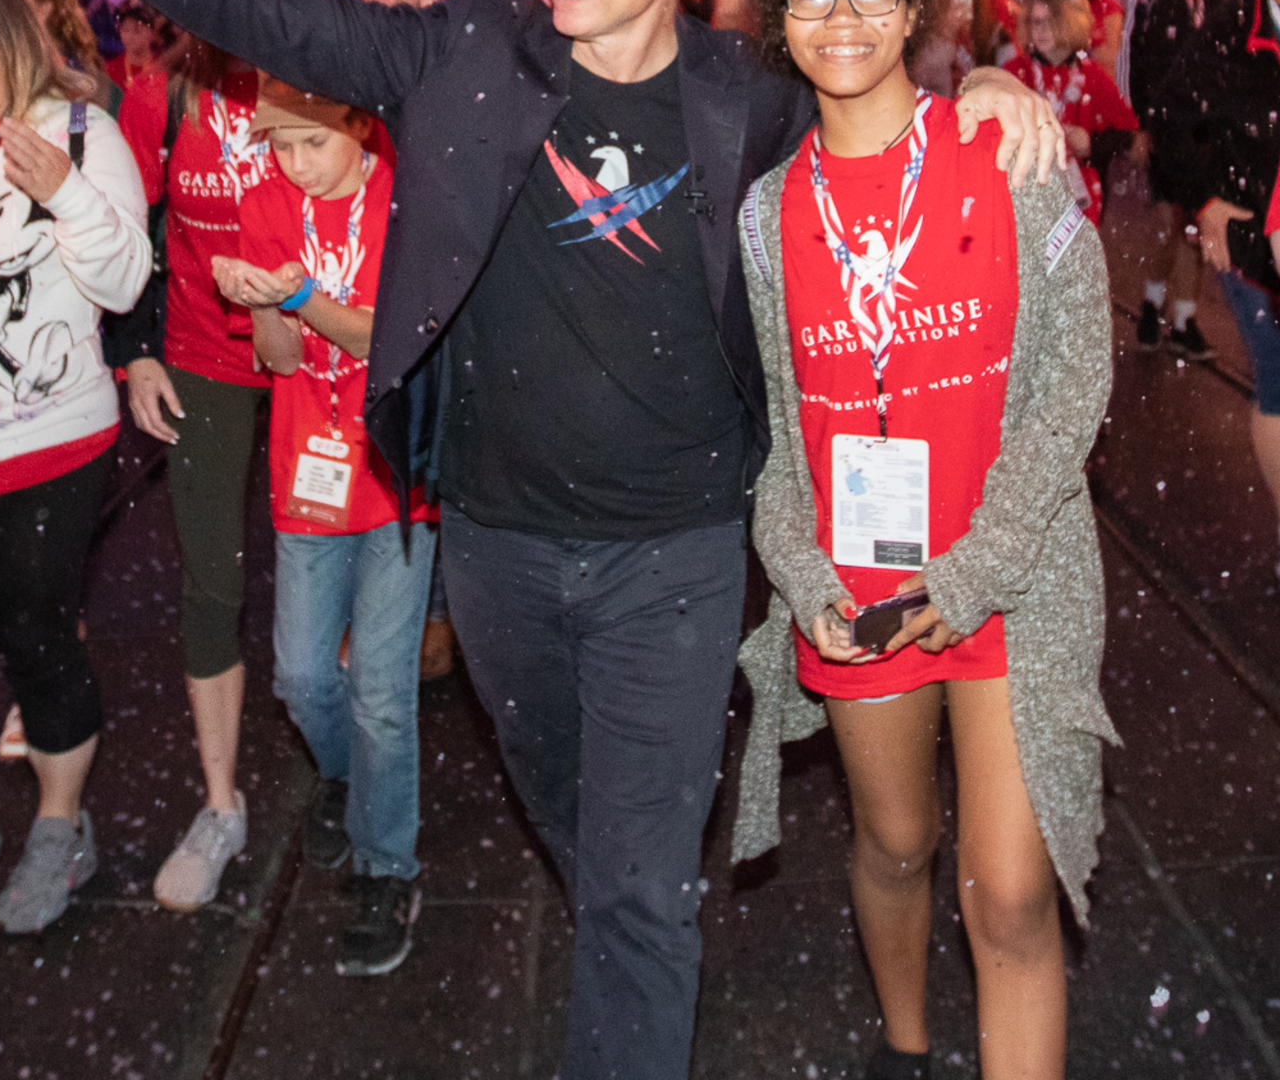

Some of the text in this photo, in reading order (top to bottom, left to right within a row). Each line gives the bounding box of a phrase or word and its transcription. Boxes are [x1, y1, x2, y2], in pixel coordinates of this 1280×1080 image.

[178, 170, 234, 189] GARY
[801, 297, 984, 348] GAR INISE
[824, 324, 961, 356] FOUATION
[928, 374, 973, 391] HERO
